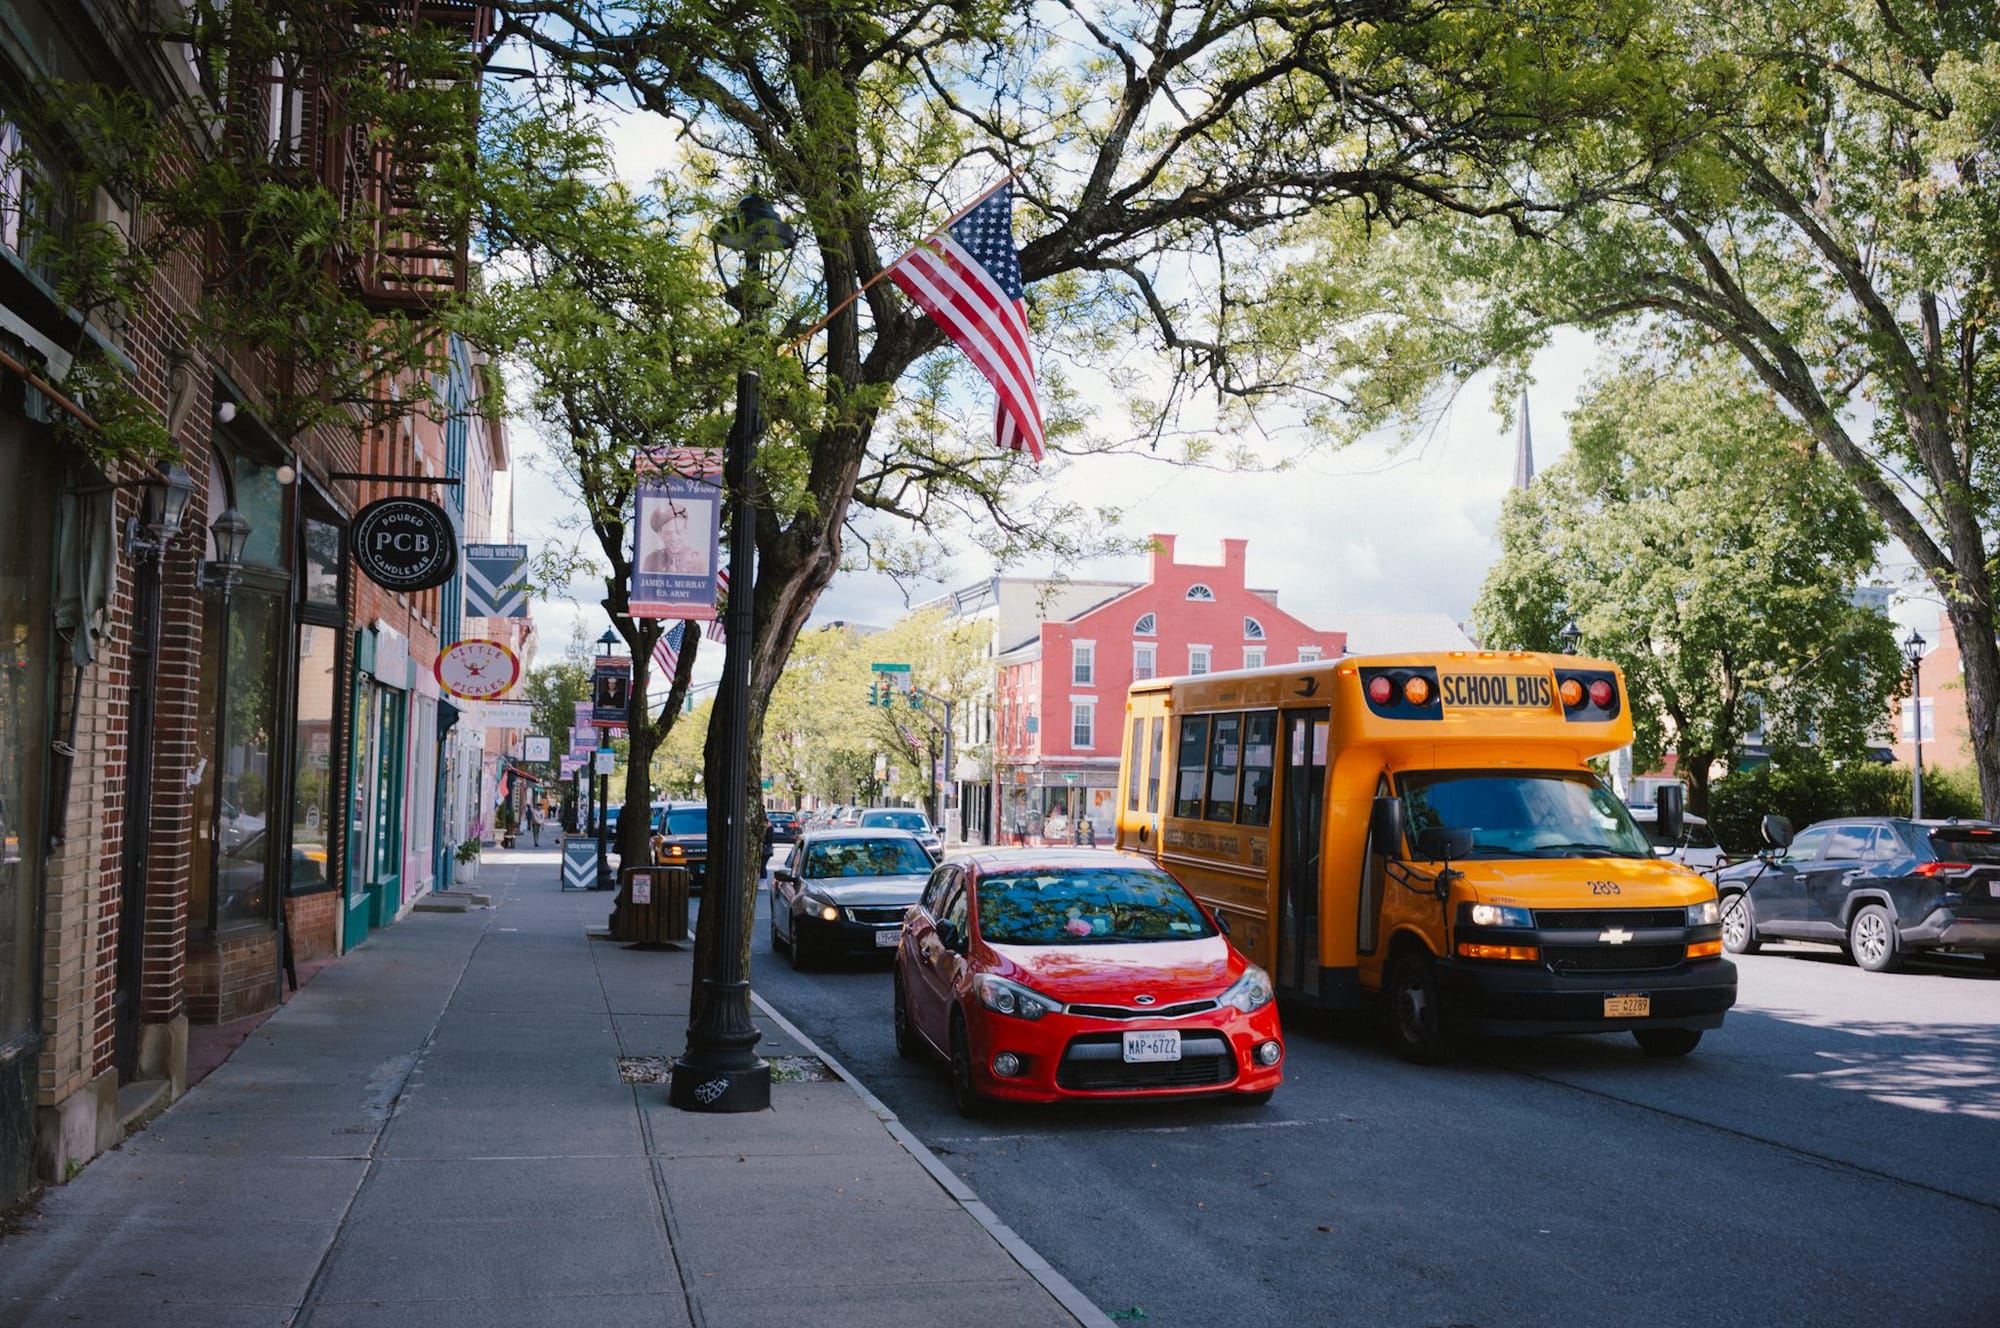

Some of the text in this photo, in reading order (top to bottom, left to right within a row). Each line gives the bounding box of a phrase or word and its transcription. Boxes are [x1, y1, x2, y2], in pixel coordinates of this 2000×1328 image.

[382, 513, 424, 527] POURED
[376, 532, 430, 552] PCB
[469, 545, 524, 559] valley variety
[374, 554, 430, 575] CANDLE BAR
[640, 577, 707, 589] JAMES L. MURRAY
[670, 590, 690, 599] ARMY
[450, 645, 503, 660] LITTLE
[453, 679, 505, 695] PICKLES
[1443, 675, 1551, 706] SCHOOL BUS
[1587, 880, 1621, 895] 289
